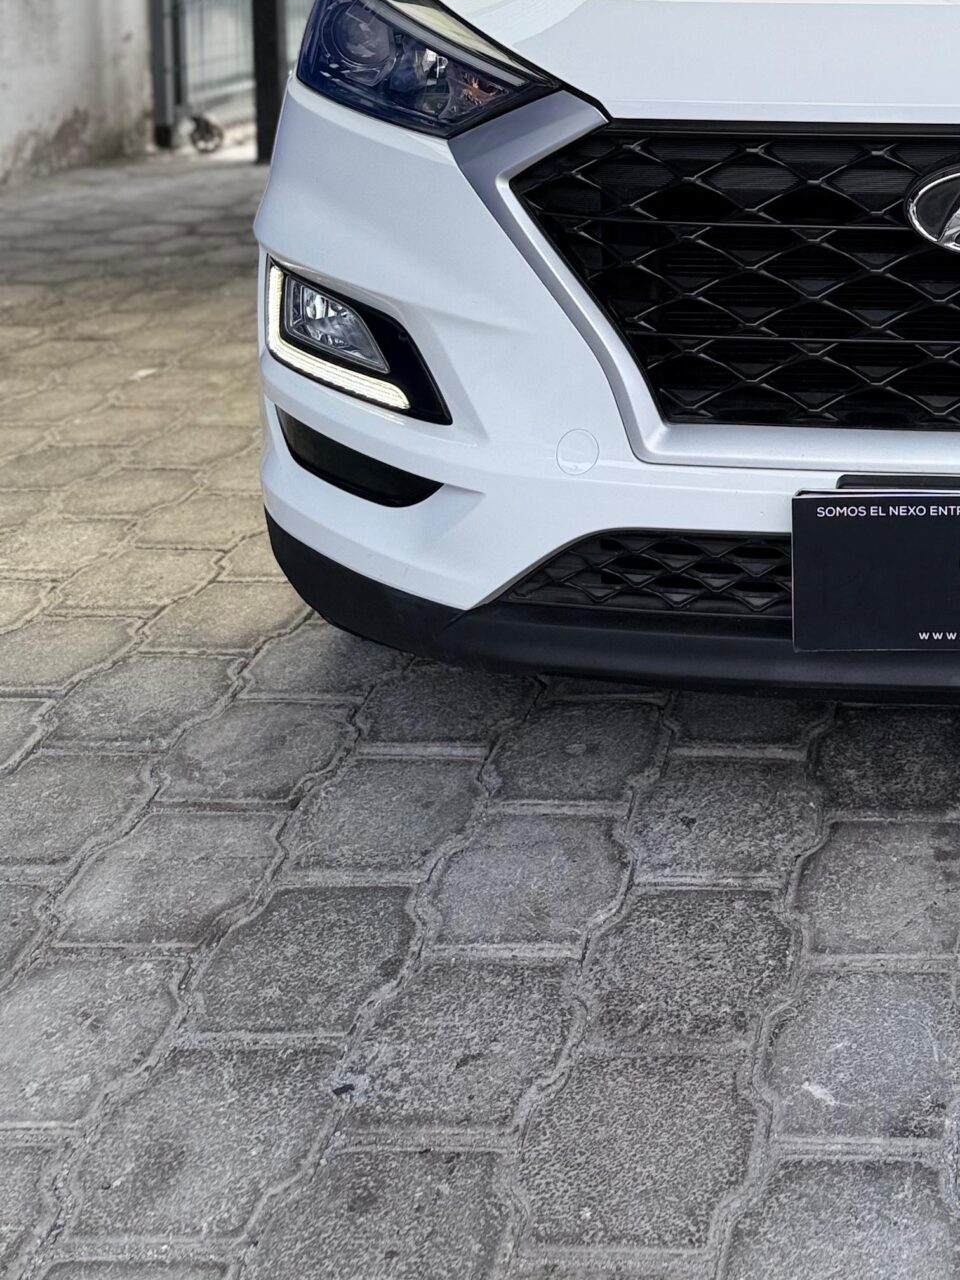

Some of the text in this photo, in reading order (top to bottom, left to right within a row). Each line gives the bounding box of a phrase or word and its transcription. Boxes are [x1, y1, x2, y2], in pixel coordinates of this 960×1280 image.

[816, 506, 867, 518] SOMOS
[870, 506, 887, 517] EL
[889, 505, 927, 517] NEXO
